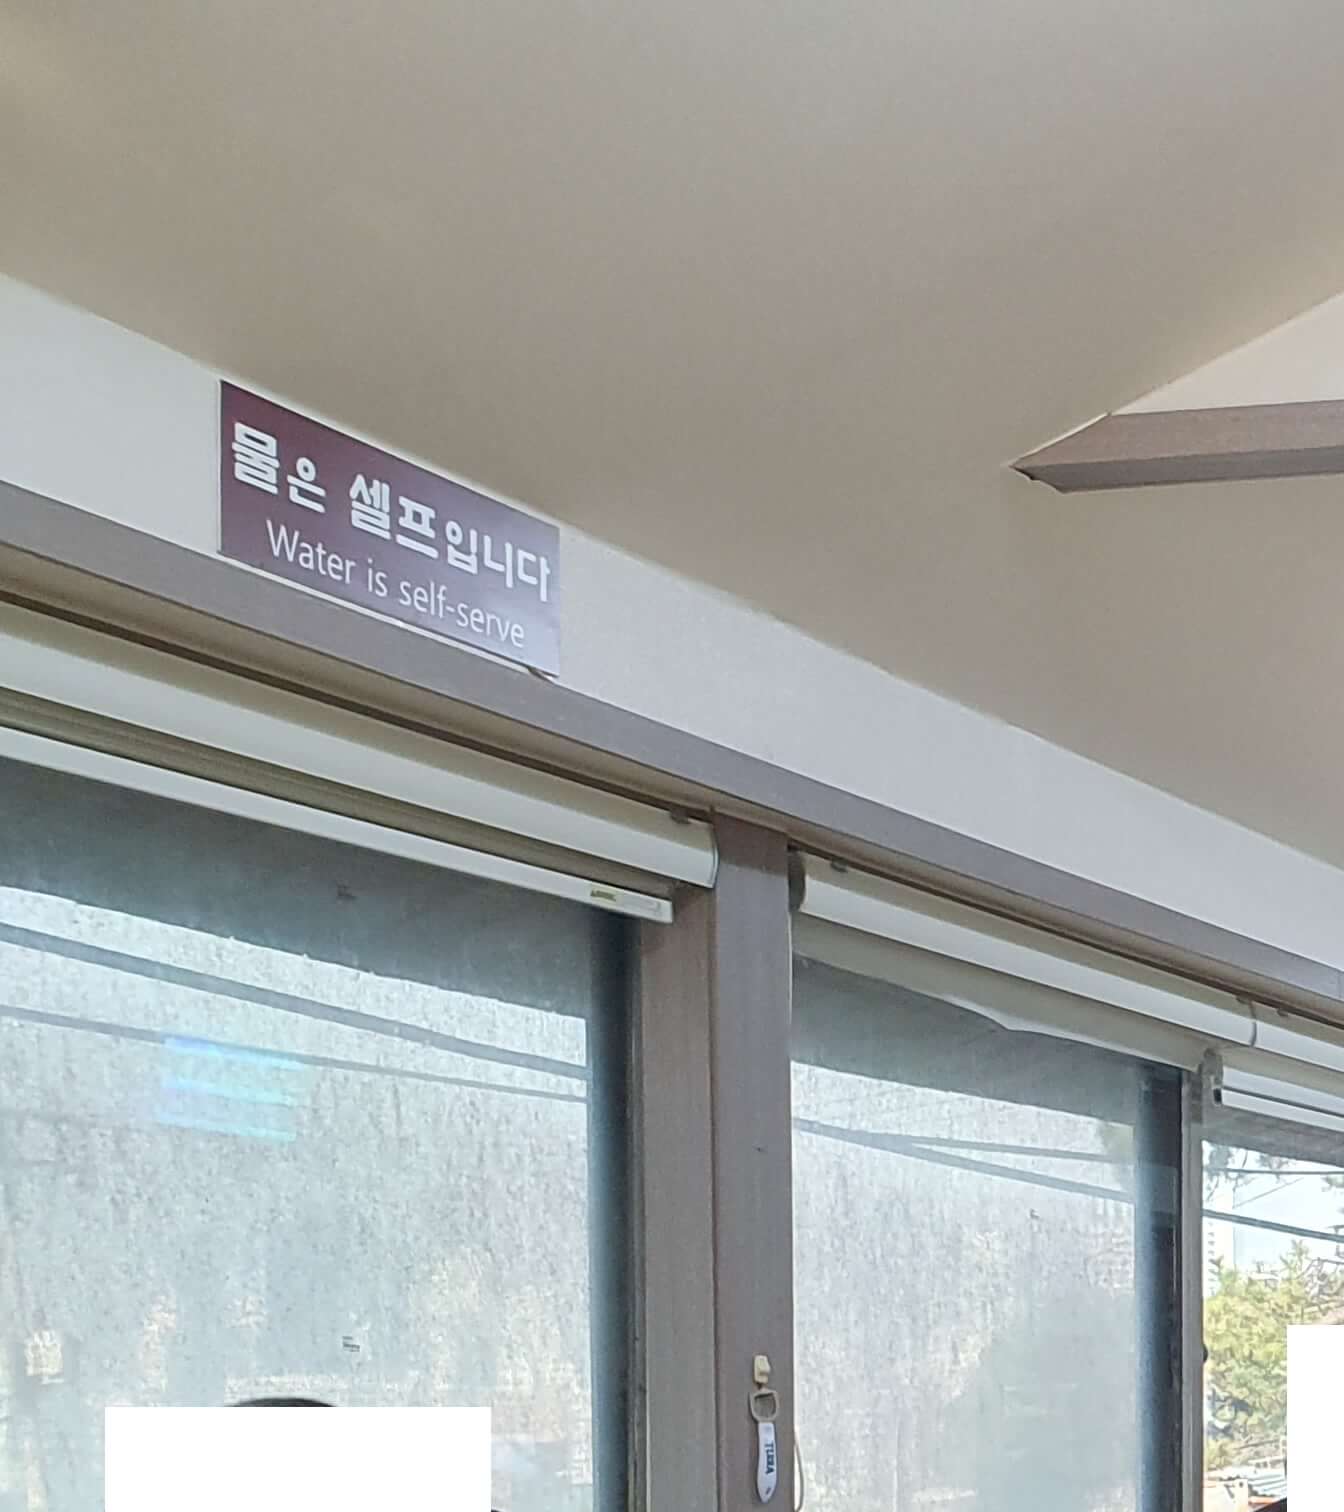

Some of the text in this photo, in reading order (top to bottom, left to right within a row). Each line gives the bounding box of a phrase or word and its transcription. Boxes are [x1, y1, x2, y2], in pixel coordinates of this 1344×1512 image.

[231, 421, 551, 602] 물은 셀프입니다
[266, 519, 526, 648] Water is self-serve
